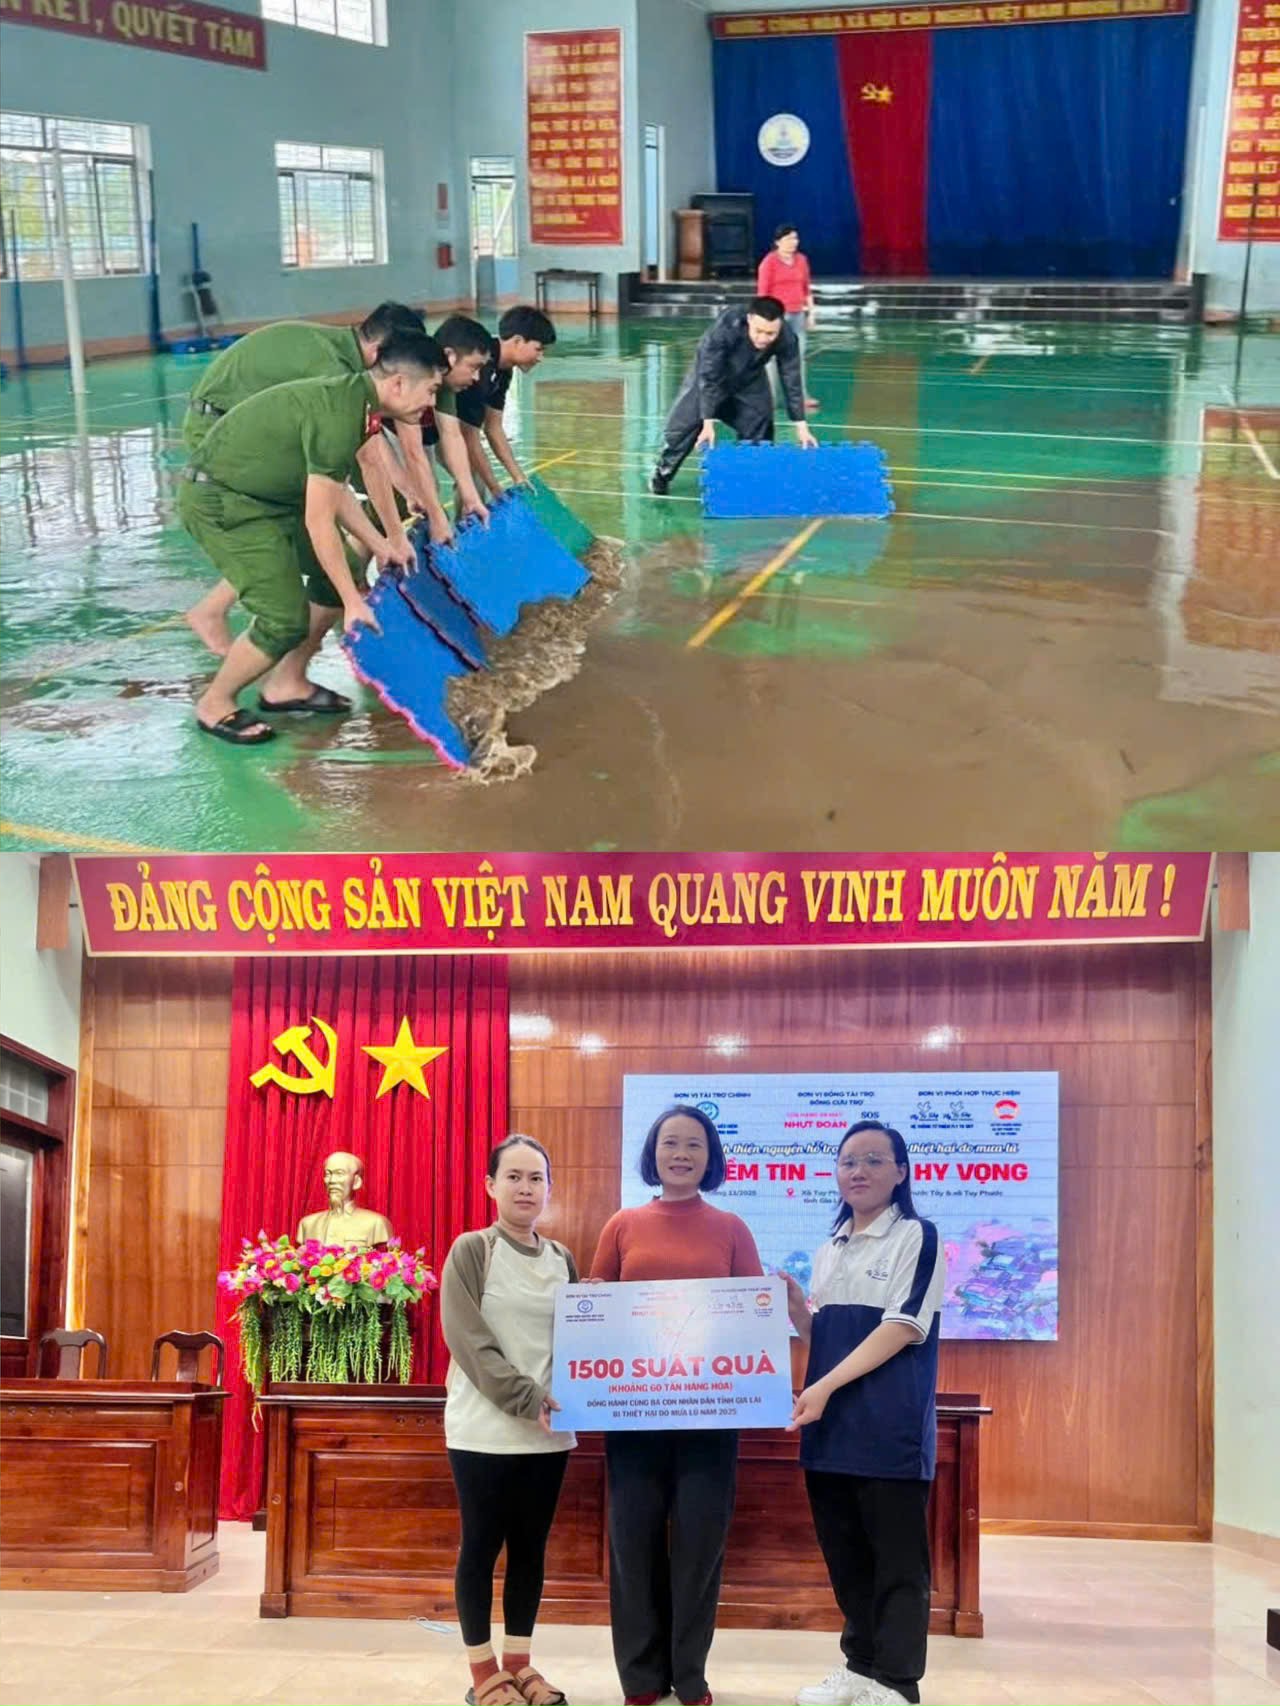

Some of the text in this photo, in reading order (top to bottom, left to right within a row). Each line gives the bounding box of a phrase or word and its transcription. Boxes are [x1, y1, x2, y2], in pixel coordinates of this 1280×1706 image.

[111, 2, 198, 46] QUYẾT
[204, 17, 257, 58] TÂM
[106, 861, 218, 932] ĐẢNG
[228, 862, 332, 943] CỘNG
[342, 857, 421, 930] SẢN
[432, 860, 529, 941] VIỆT
[544, 874, 634, 927] NAM
[648, 871, 788, 937] QUANG
[800, 869, 907, 923] VINH
[917, 851, 1039, 922] MUÔN
[1047, 852, 1154, 919] NĂM
[765, 1163, 806, 1181] TIN
[914, 1163, 1029, 1185] HY VỌNG
[568, 1359, 624, 1380] 1500
[711, 1349, 776, 1377] QUÀ
